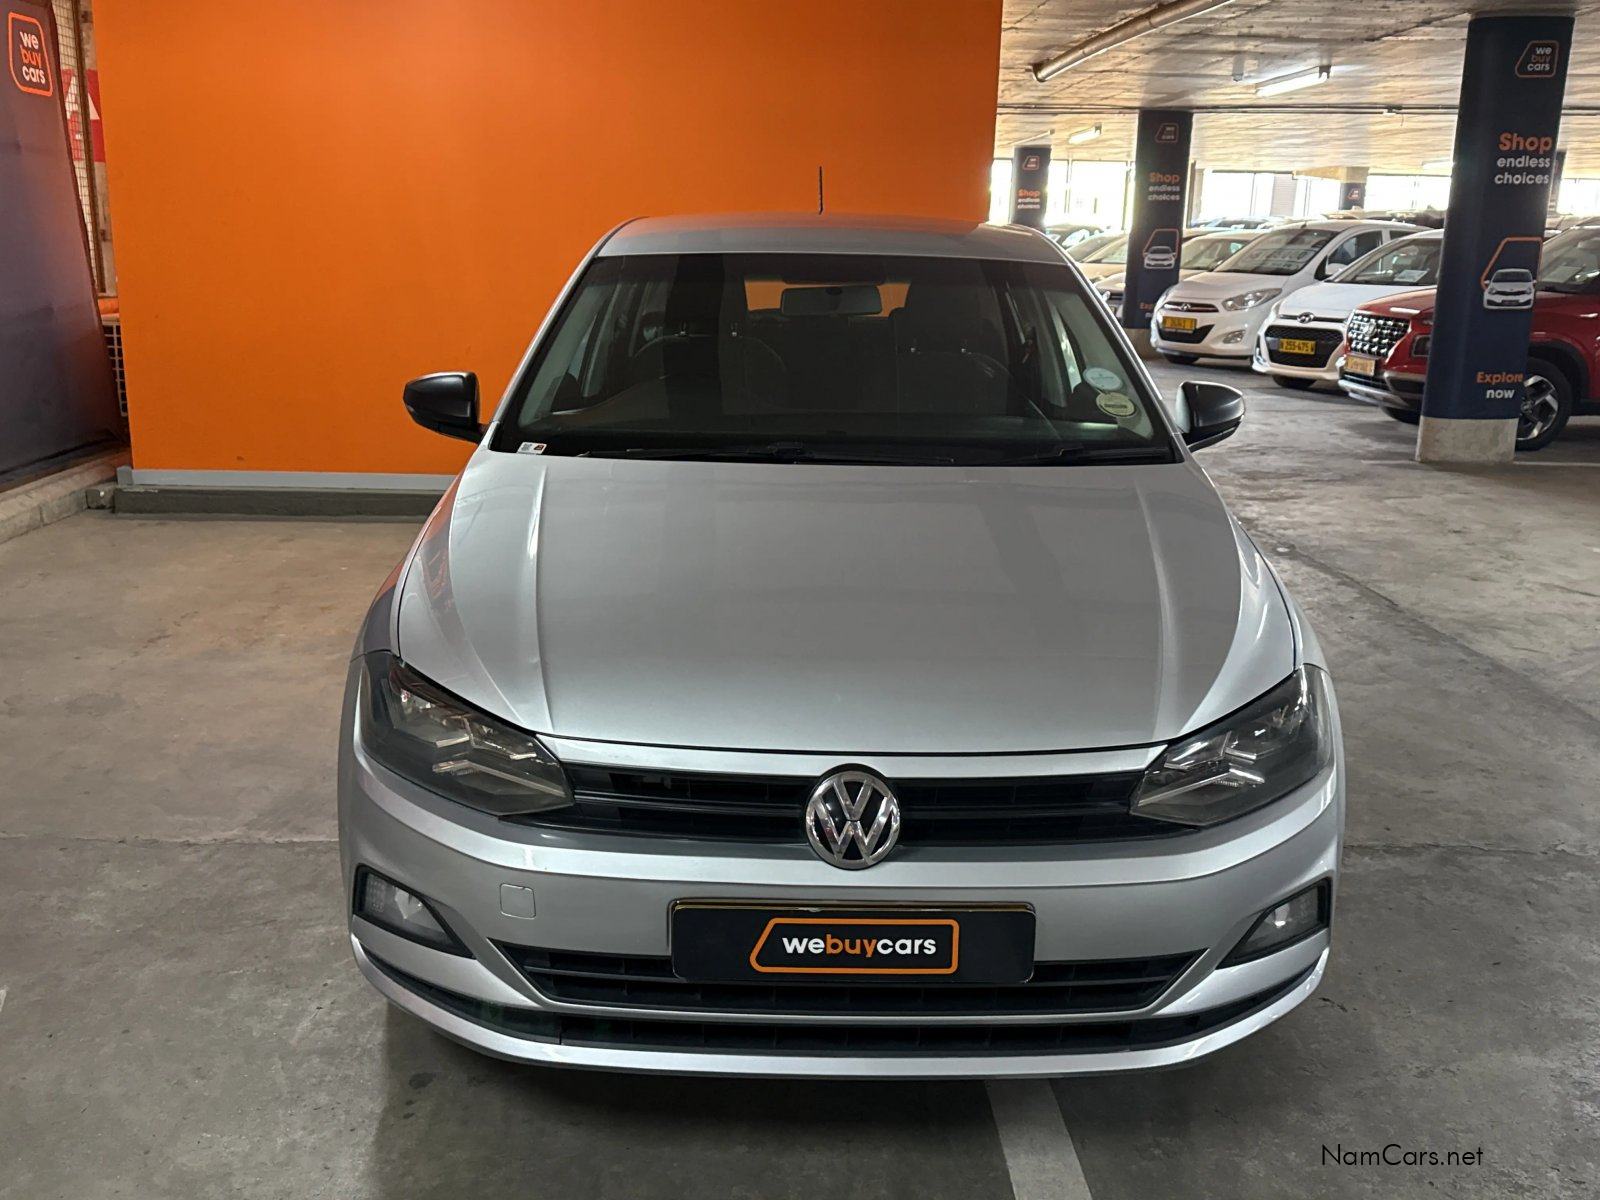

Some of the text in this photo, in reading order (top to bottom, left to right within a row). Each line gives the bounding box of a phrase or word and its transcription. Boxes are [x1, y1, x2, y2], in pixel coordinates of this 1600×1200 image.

[20, 32, 39, 49] we
[20, 44, 42, 69] buy
[1535, 47, 1552, 55] we
[1531, 54, 1551, 65] buy
[1527, 62, 1550, 71] cars
[22, 65, 46, 84] cars
[1499, 132, 1553, 154] Shop
[1496, 156, 1551, 168] endless
[1149, 171, 1180, 184] Shop
[1494, 172, 1549, 185] choices
[1486, 389, 1515, 399] now
[782, 934, 936, 958] webuycars
